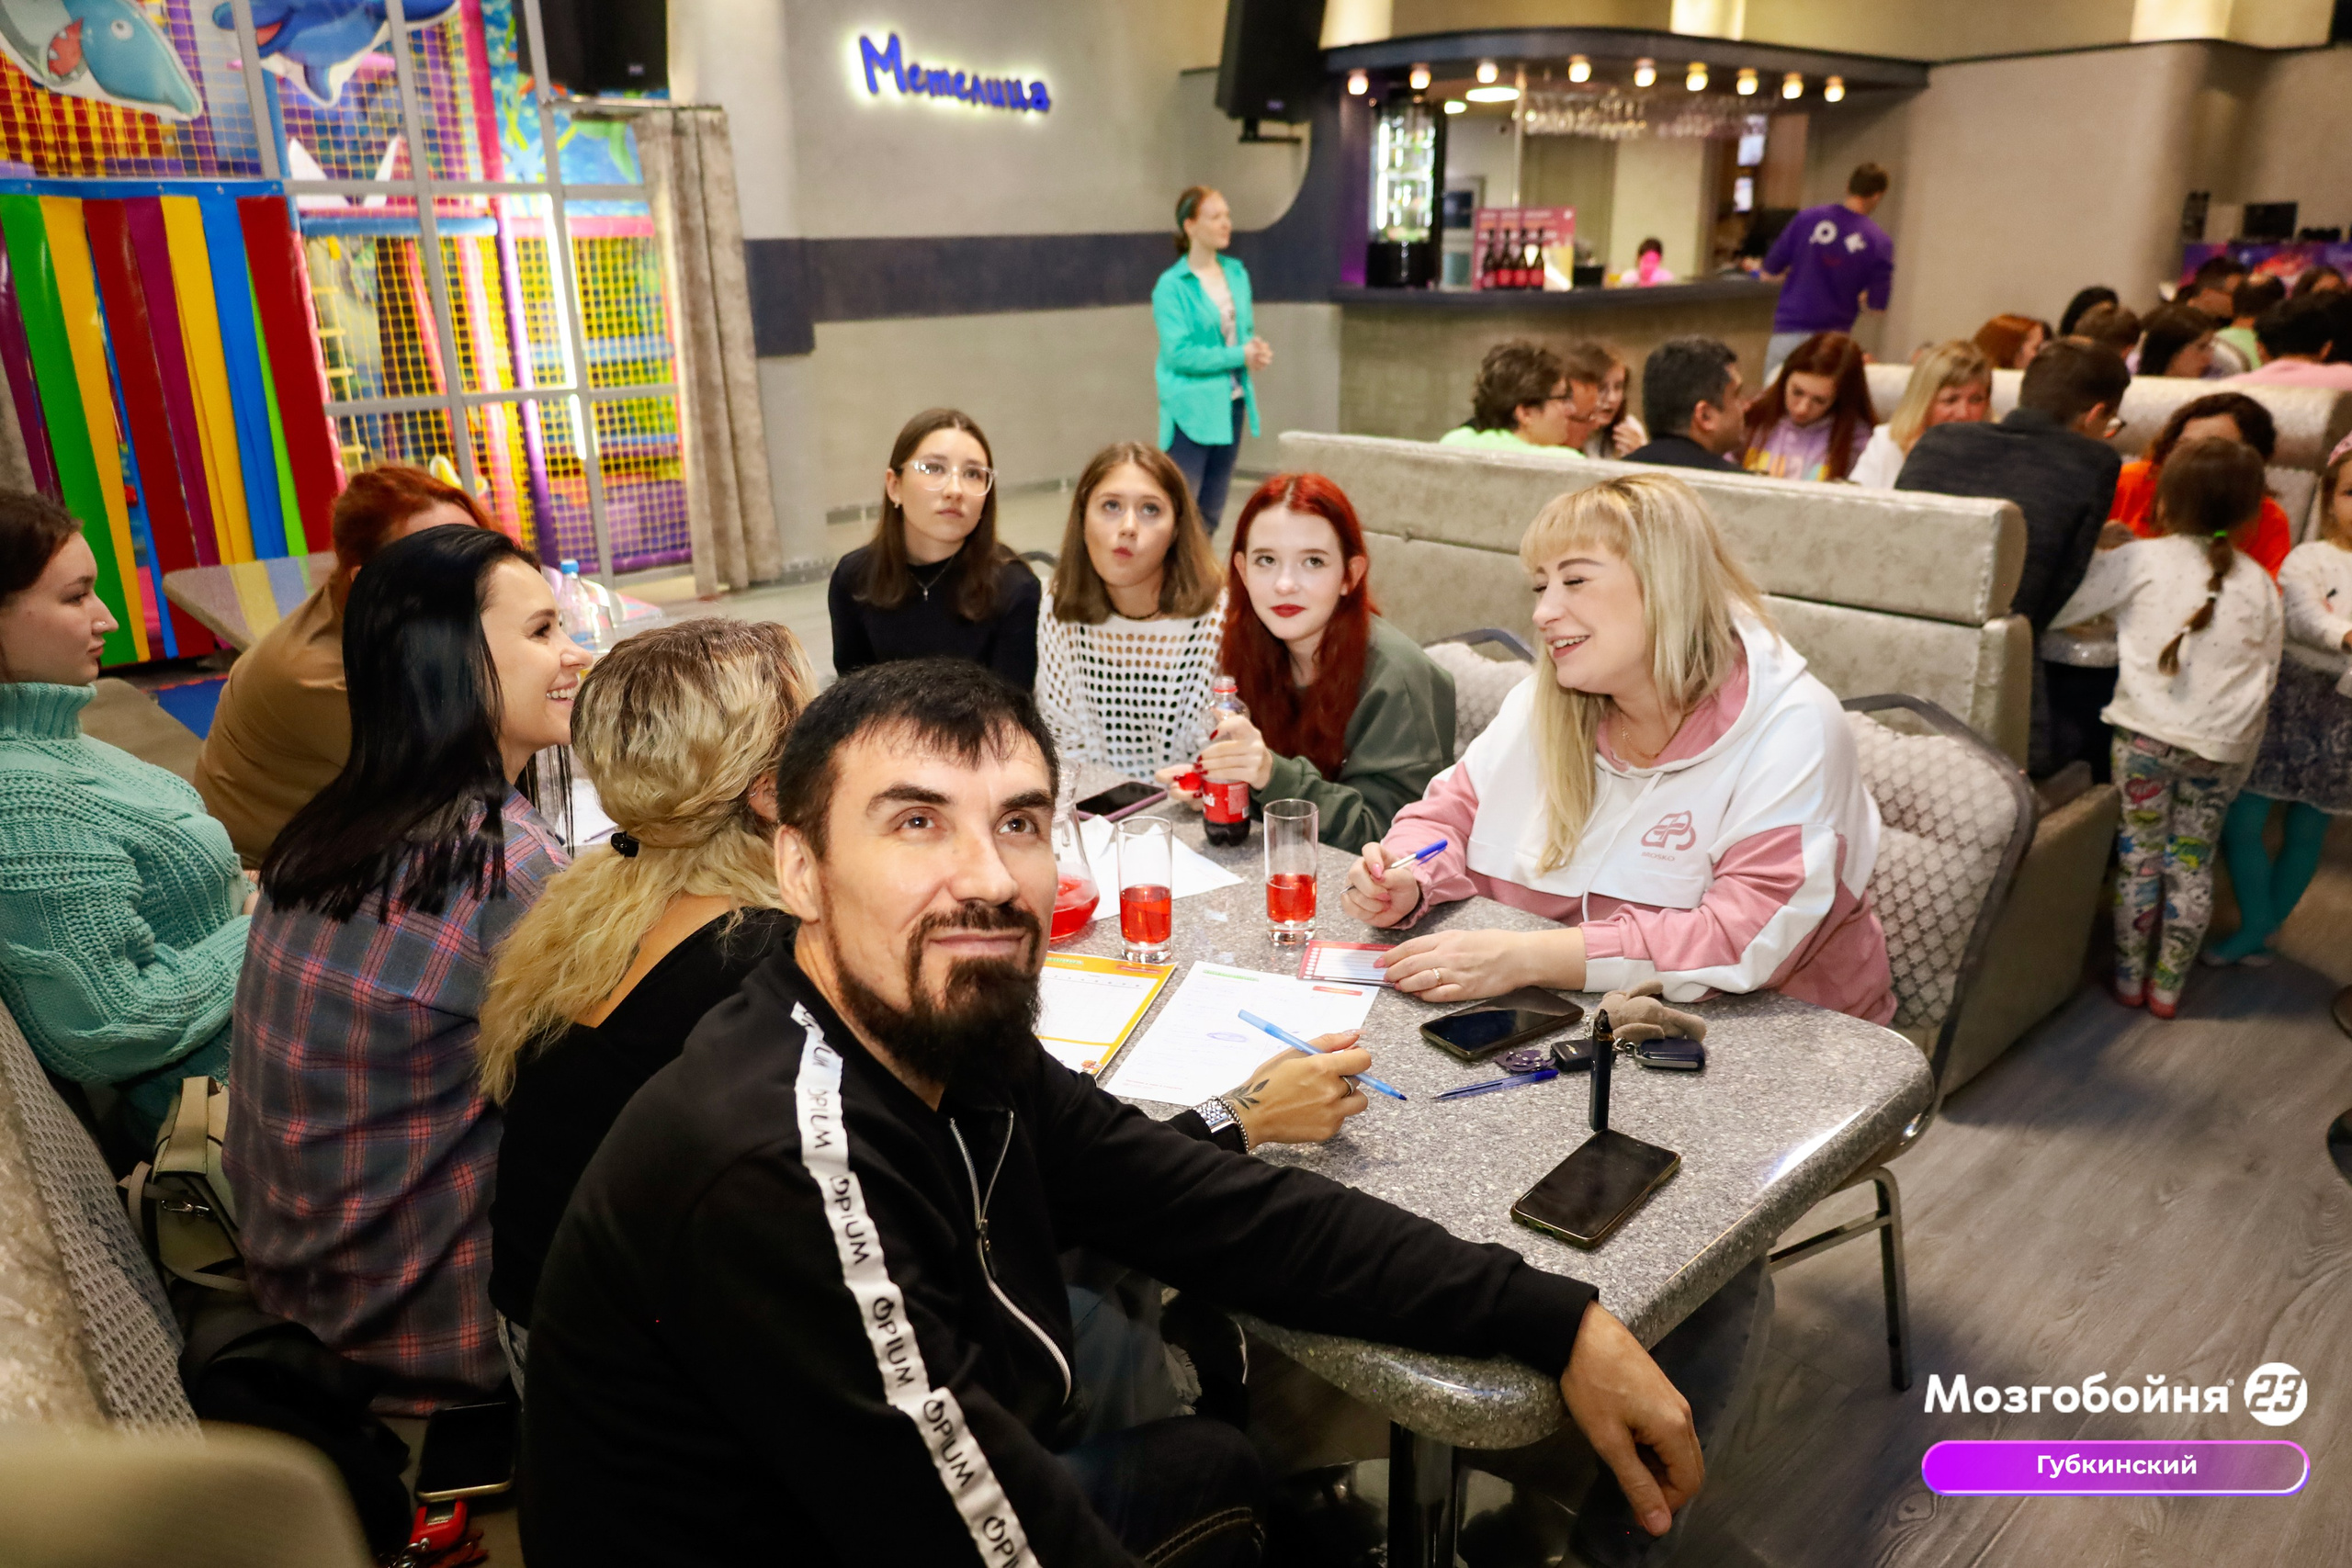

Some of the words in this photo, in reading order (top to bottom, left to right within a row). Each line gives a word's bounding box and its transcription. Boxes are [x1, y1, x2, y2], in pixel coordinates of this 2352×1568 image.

[859, 32, 1051, 113] Метелица
[830, 1175, 870, 1266] OPIUM
[874, 1297, 915, 1388] OPIUM
[923, 1399, 975, 1487] OPIUM
